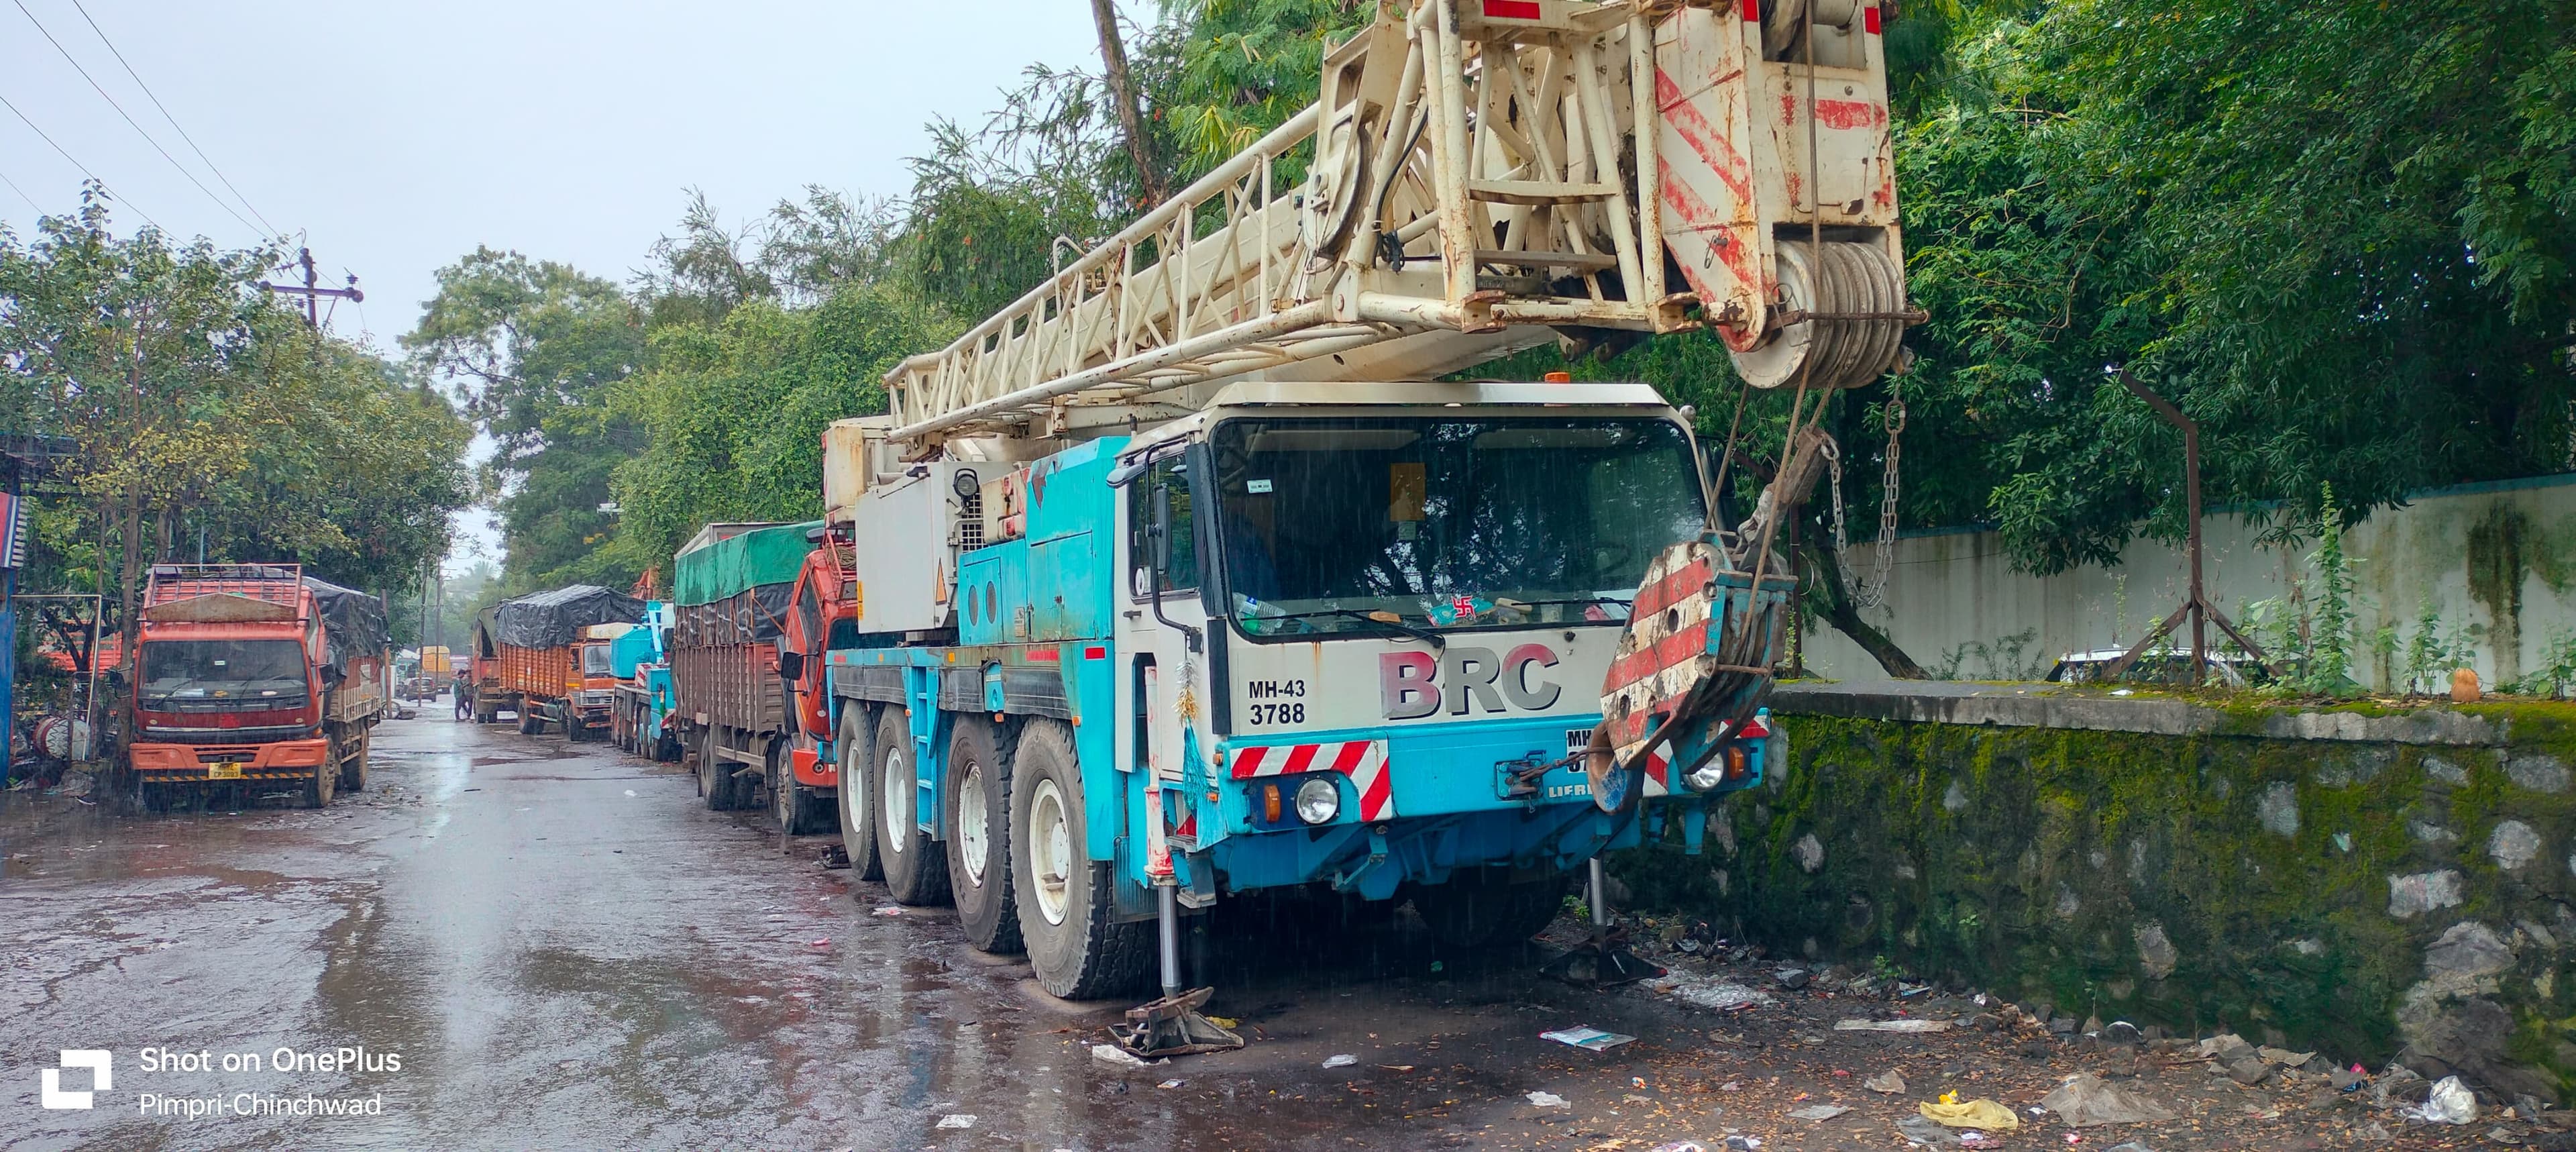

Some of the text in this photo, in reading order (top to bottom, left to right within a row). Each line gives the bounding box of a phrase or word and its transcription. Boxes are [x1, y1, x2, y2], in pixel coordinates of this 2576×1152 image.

[1249, 680, 1305, 698] MH-43
[1379, 643, 1562, 721] BRC
[1250, 702, 1305, 725] 3788
